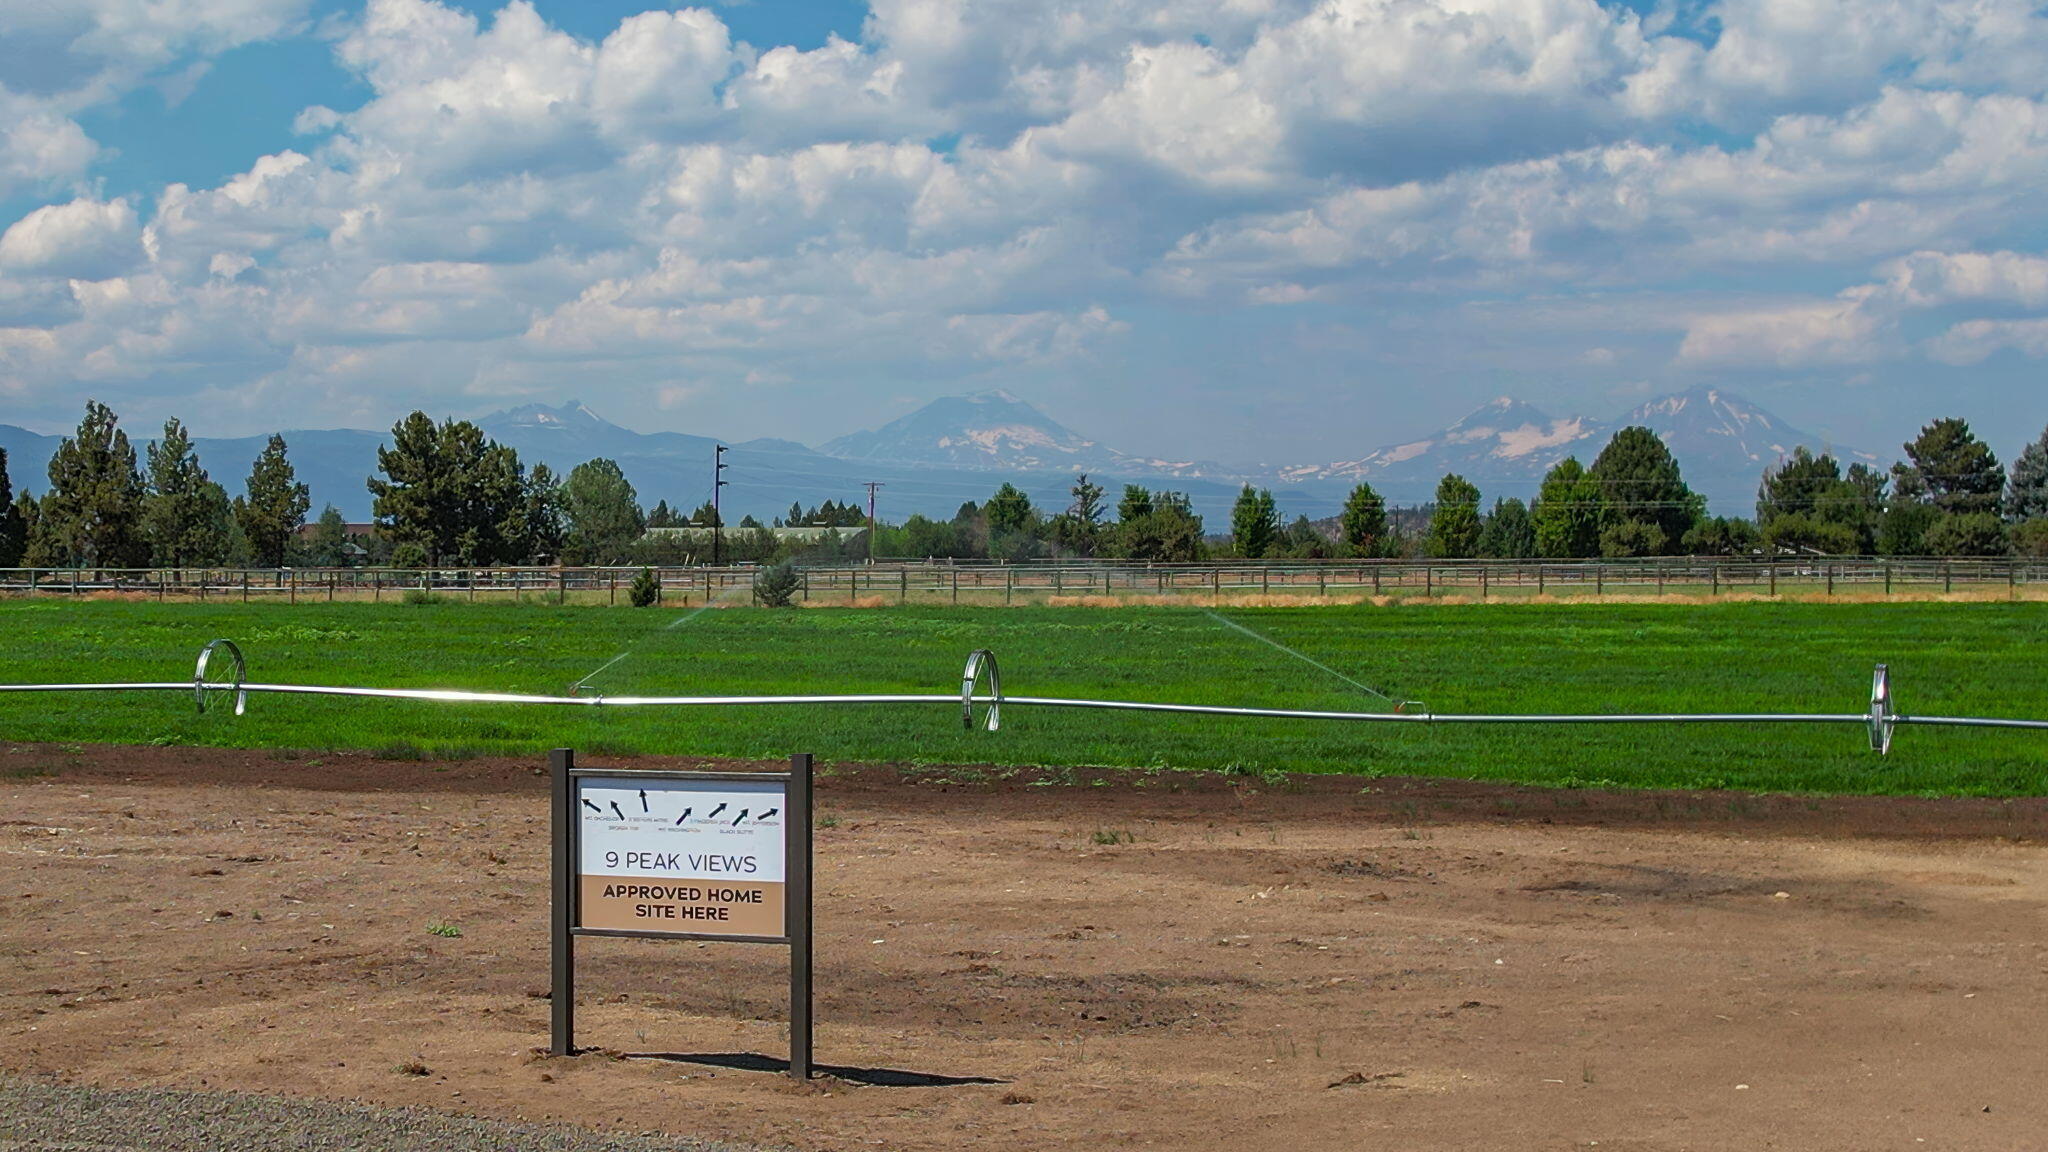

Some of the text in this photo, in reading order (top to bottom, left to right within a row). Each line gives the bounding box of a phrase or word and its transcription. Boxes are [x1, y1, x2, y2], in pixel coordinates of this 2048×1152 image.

[605, 851, 757, 873] 9 PEAK VIEWS
[603, 885, 763, 903] APPROVED HOME
[635, 904, 729, 921] SITE HERE
